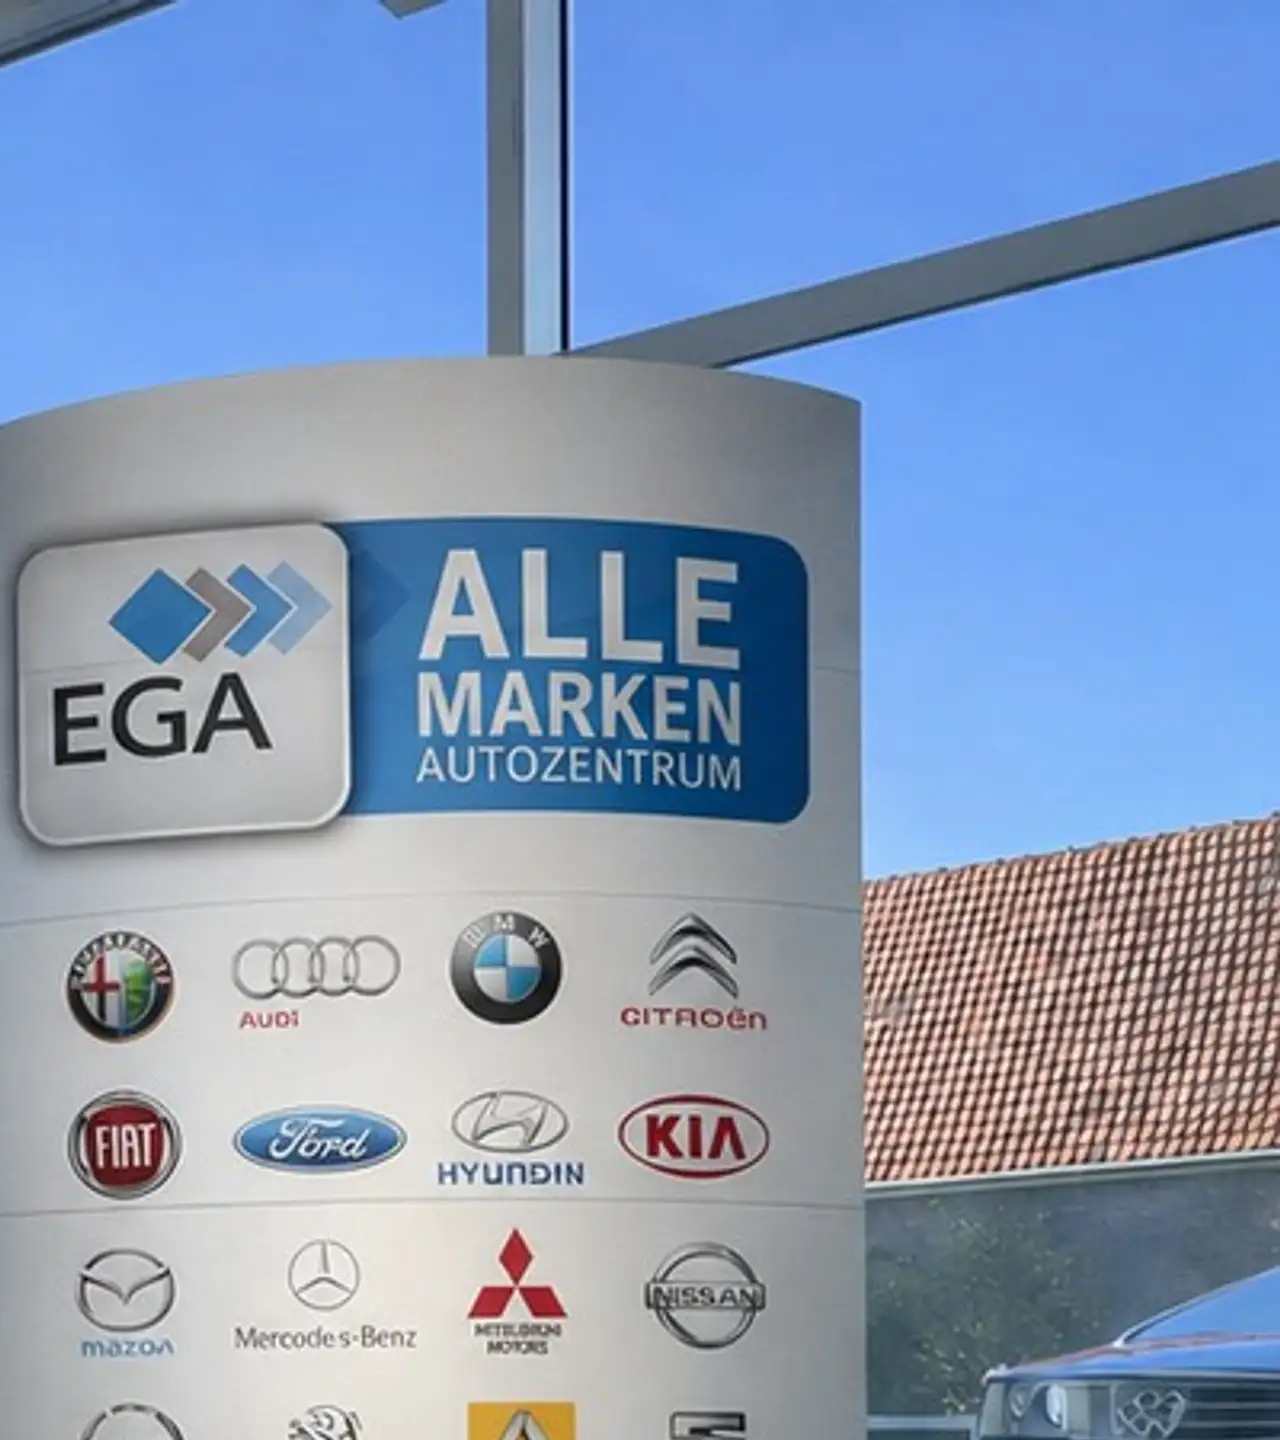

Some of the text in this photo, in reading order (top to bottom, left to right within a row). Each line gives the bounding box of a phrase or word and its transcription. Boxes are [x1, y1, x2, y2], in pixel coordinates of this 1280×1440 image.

[418, 548, 739, 671] ALLE
[51, 671, 273, 767] EGA
[417, 671, 741, 745] MARKEN
[416, 745, 742, 792] AUTOZENTRUM
[95, 1123, 157, 1169] FIAT
[269, 1118, 369, 1160] Ford
[646, 1114, 746, 1160] KIA
[653, 1286, 759, 1308] NISSAN
